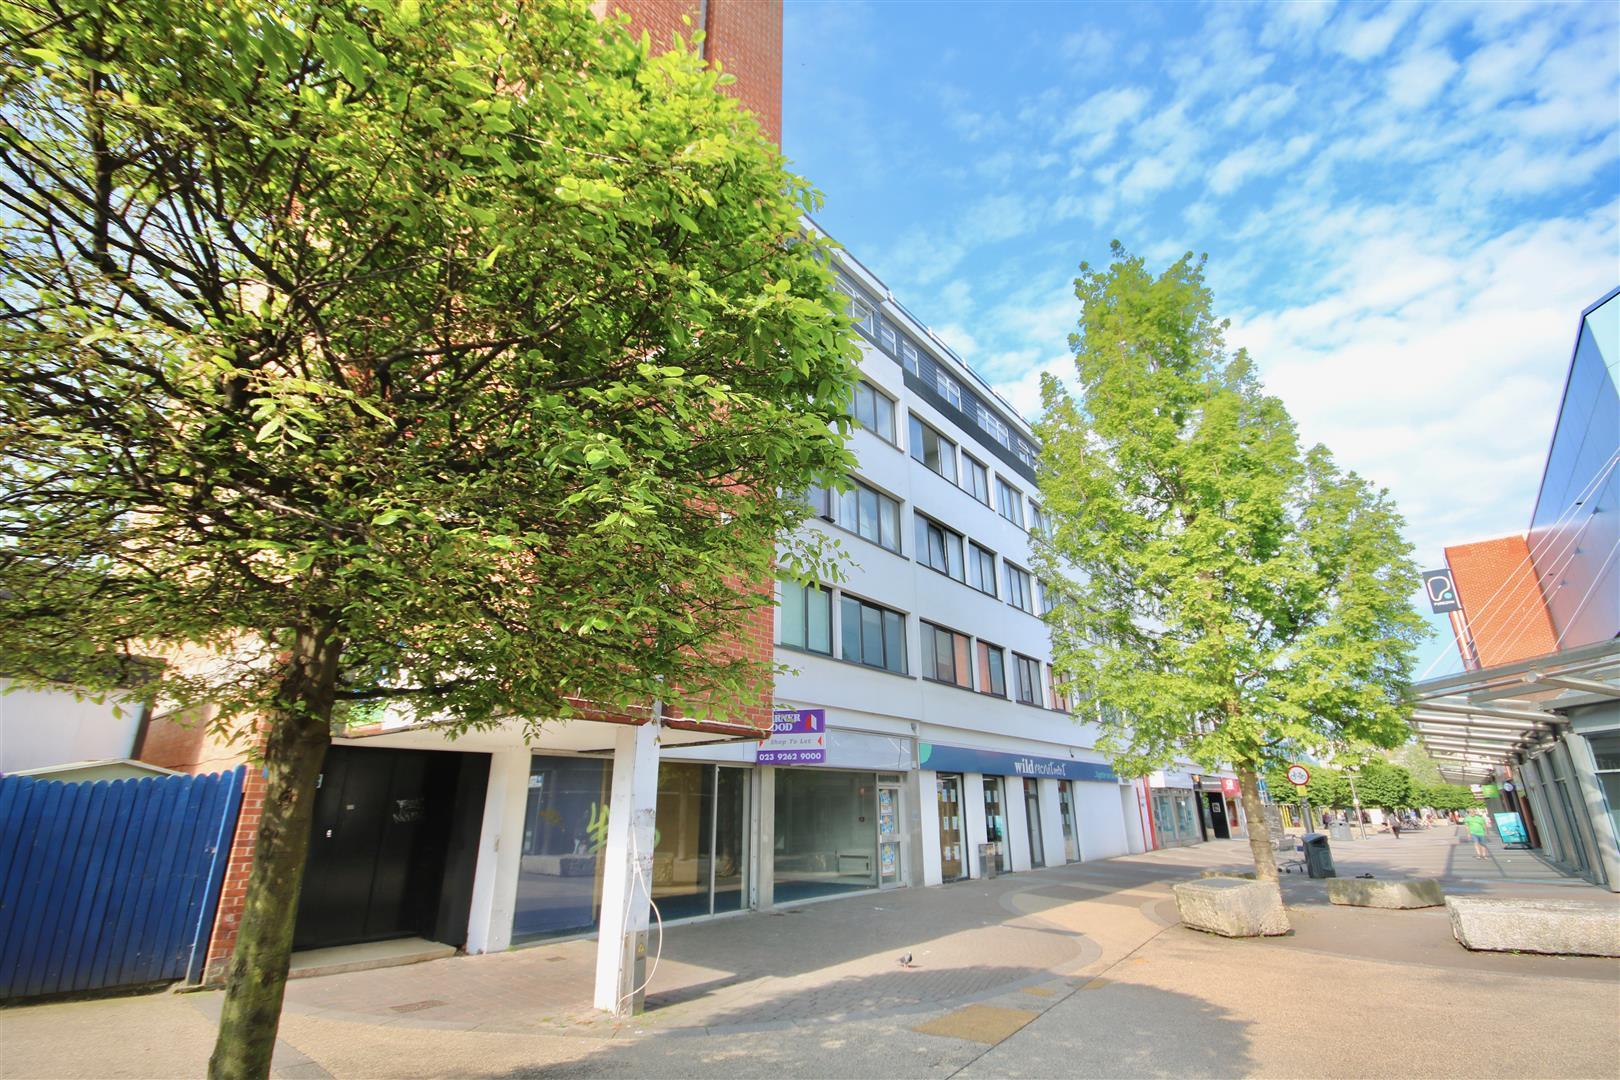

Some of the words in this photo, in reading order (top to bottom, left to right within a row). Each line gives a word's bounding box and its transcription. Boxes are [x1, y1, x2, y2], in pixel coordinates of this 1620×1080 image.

[774, 714, 801, 722] RNER
[772, 723, 793, 732] OOD
[759, 753, 775, 761] 023
[777, 753, 798, 761] 9262
[800, 752, 822, 760] 9000
